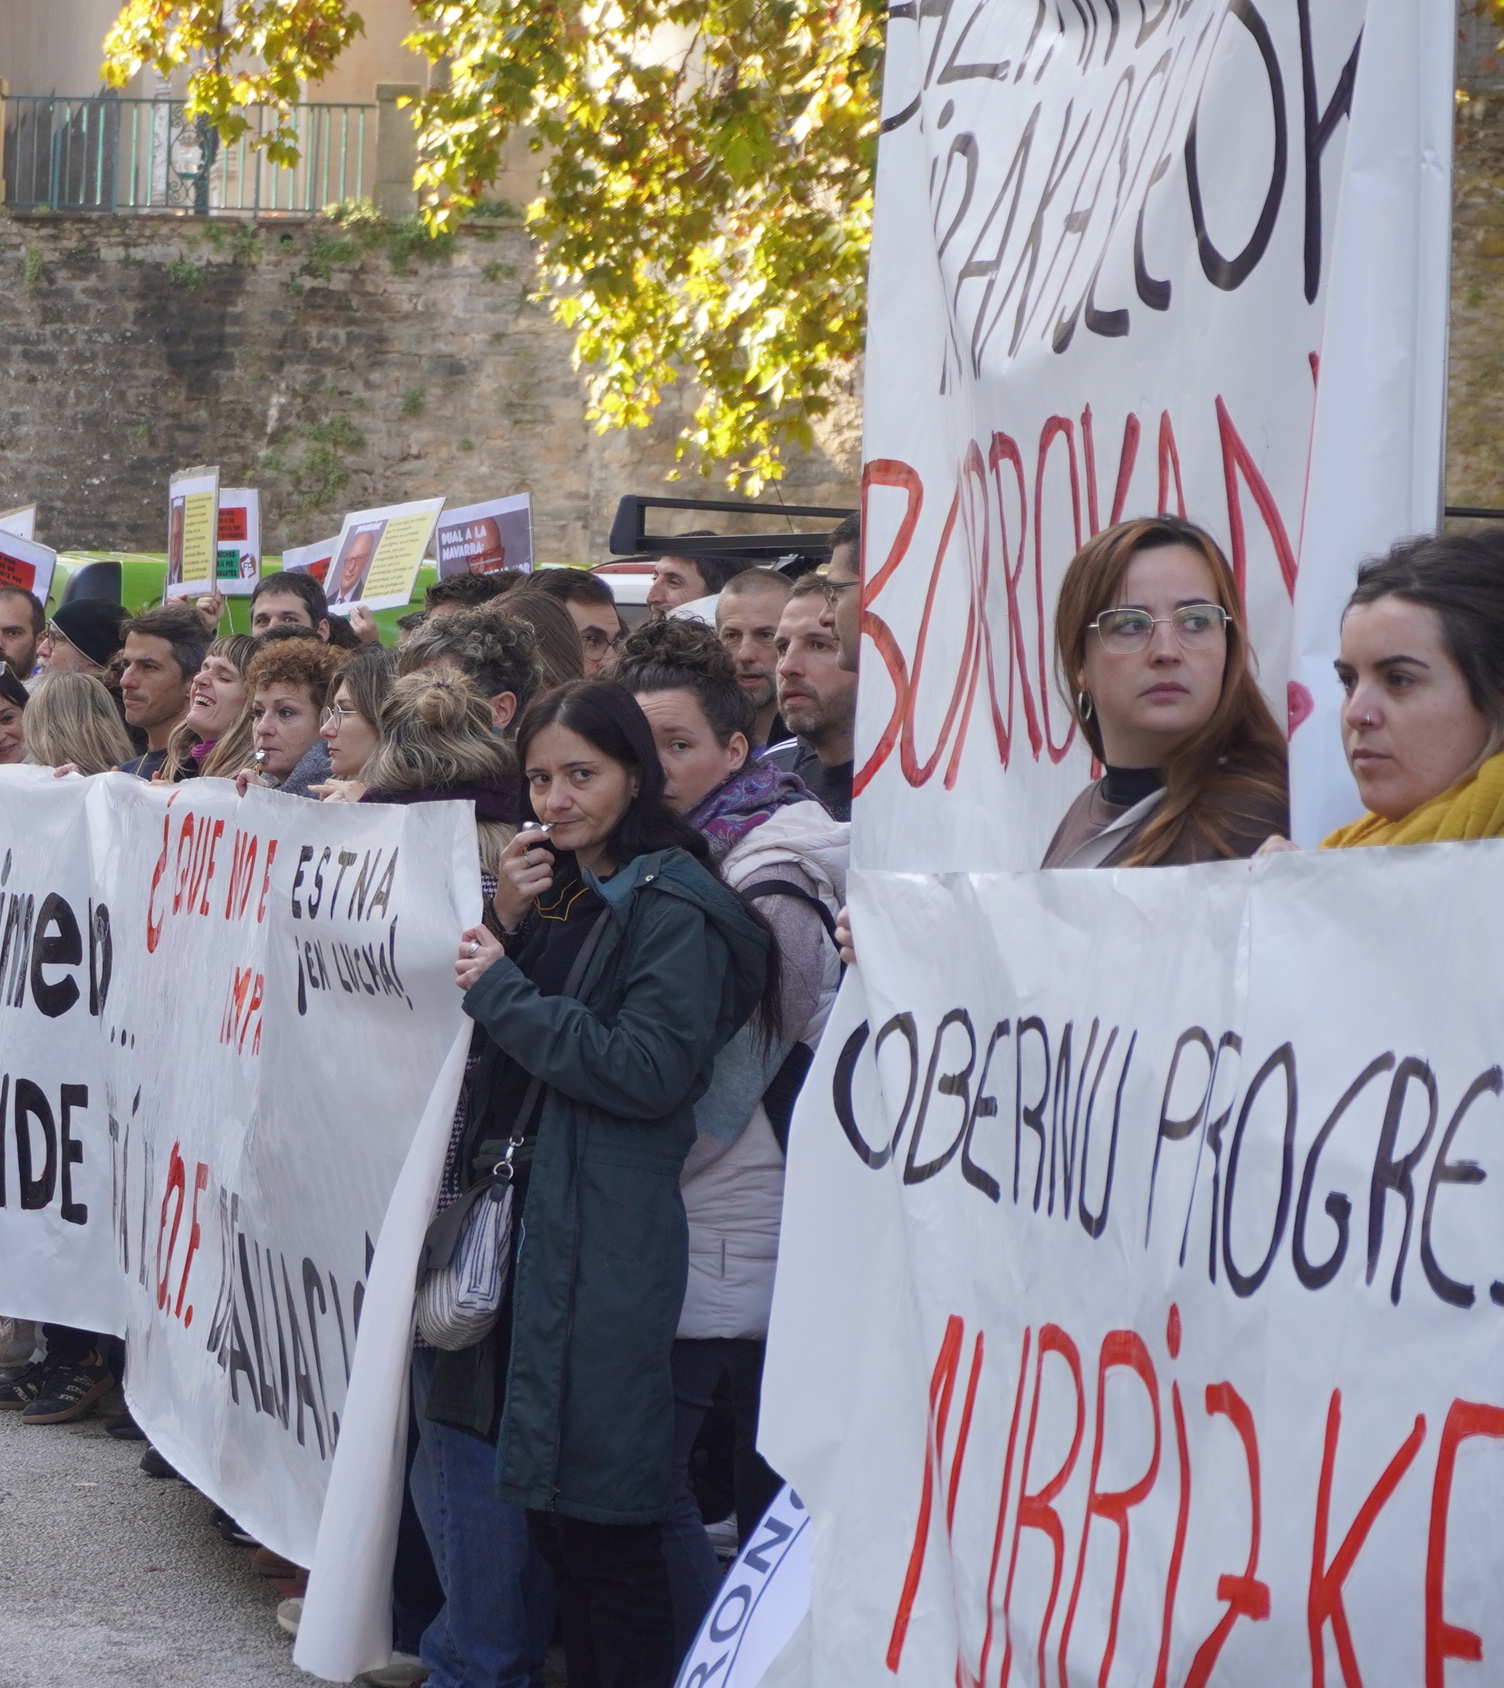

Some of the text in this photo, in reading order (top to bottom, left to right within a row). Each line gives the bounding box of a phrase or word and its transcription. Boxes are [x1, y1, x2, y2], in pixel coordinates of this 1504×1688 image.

[441, 525, 487, 546] DUAL A LA
[292, 845, 399, 922] ESTNA
[1144, 1026, 1504, 1311] PROGRE
